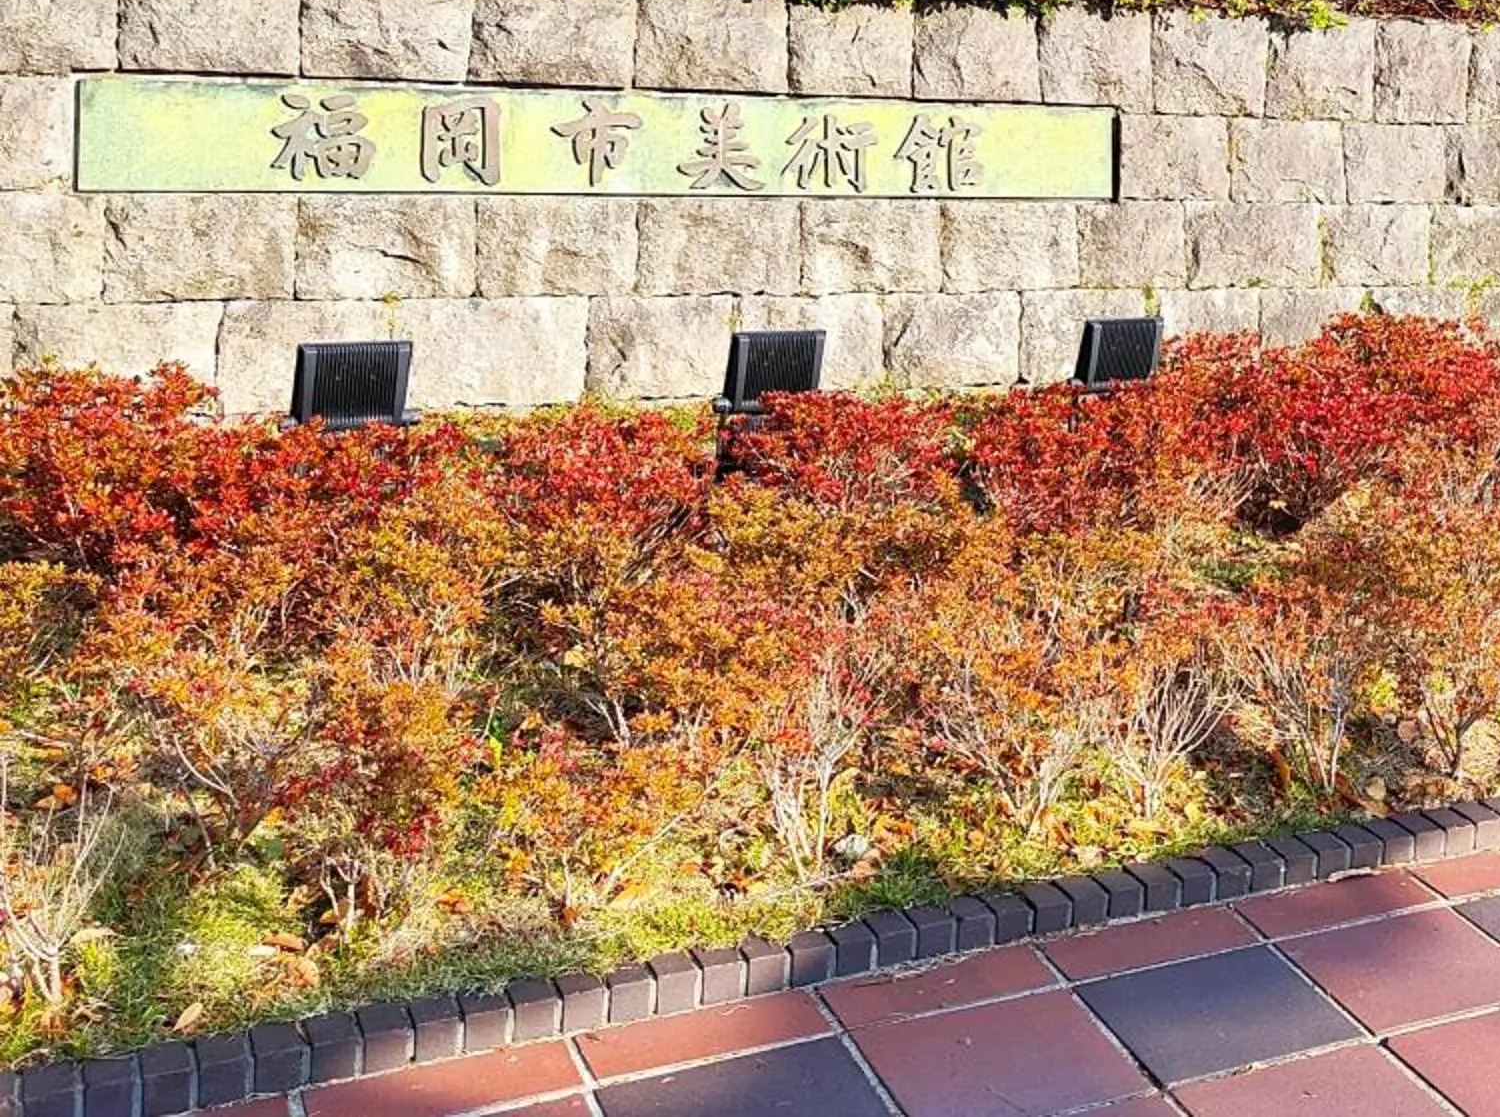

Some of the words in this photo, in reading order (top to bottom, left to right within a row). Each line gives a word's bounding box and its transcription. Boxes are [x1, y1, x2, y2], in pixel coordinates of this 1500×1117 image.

[269, 93, 984, 193] 福岡市美術館
